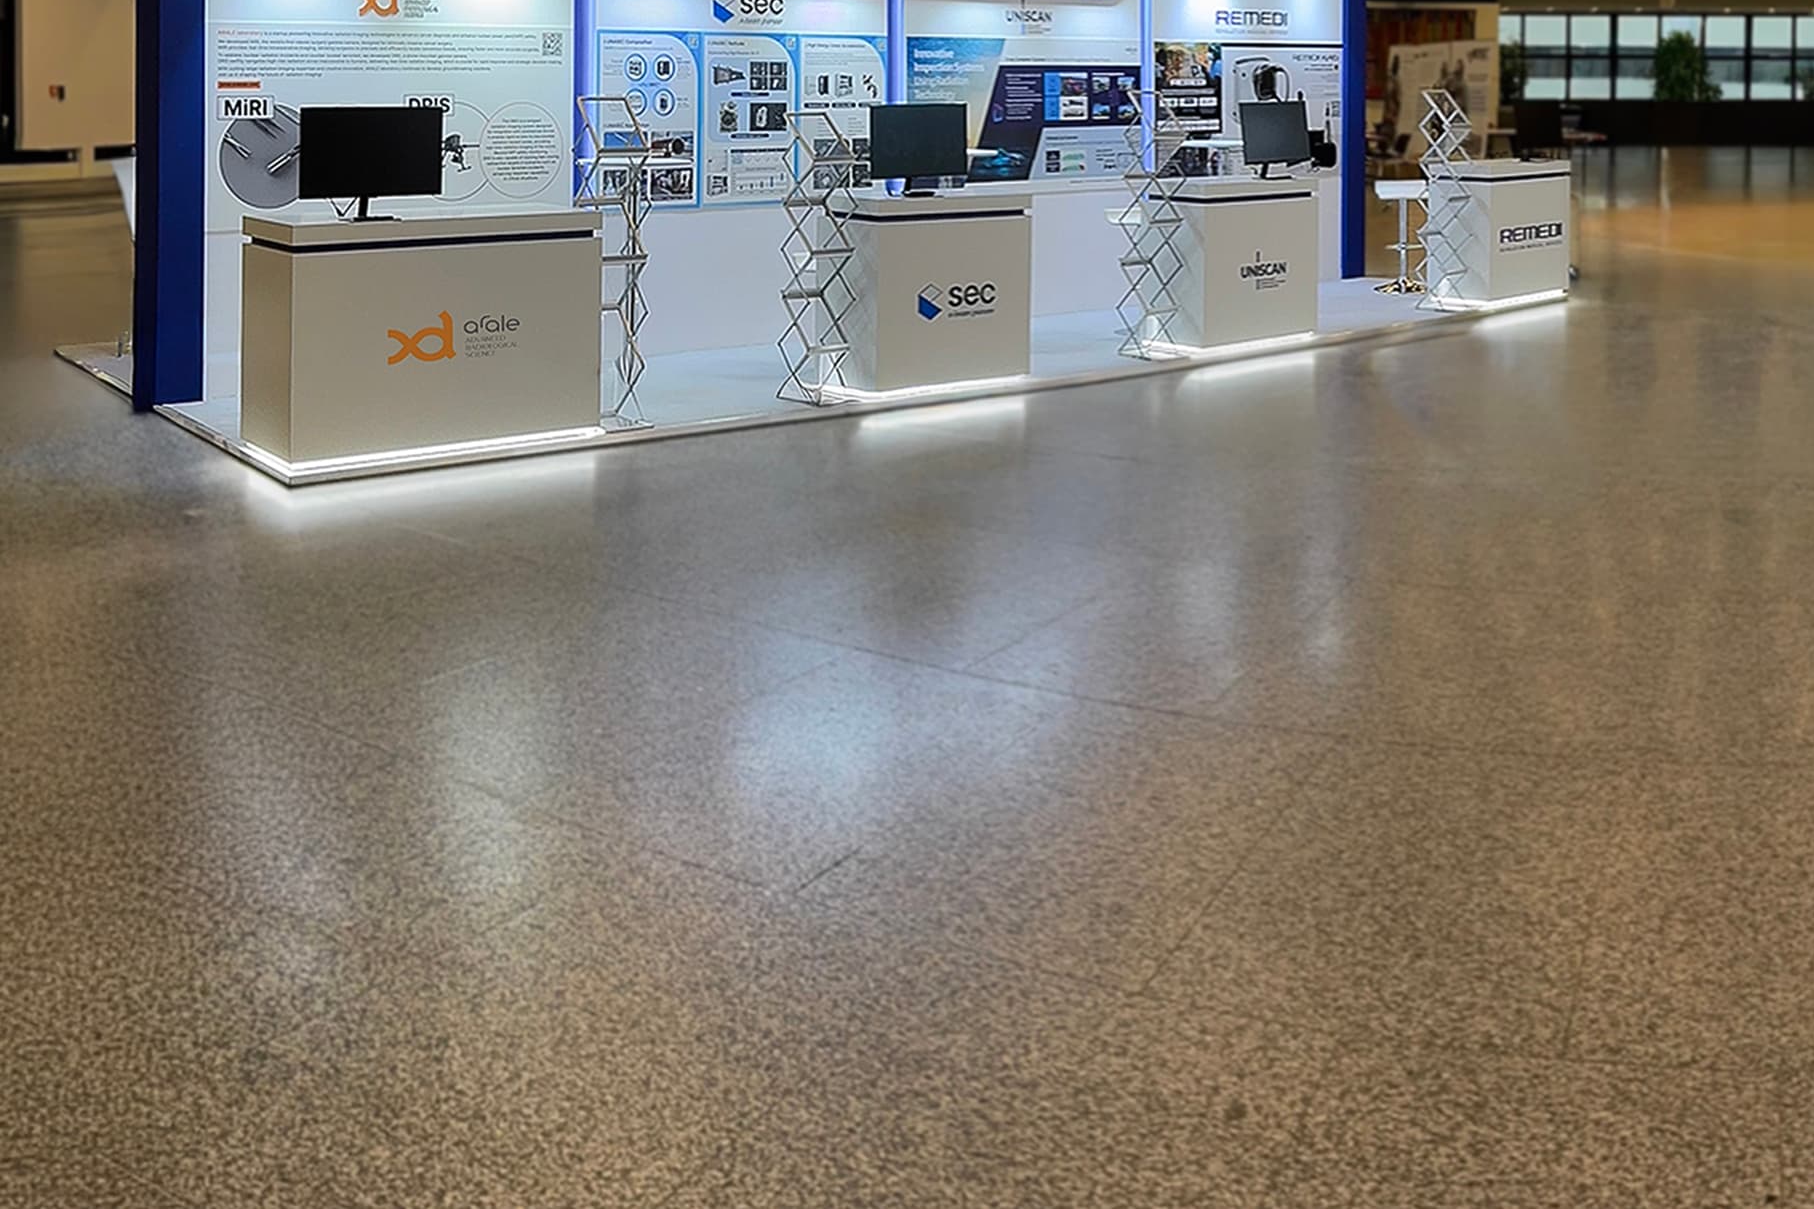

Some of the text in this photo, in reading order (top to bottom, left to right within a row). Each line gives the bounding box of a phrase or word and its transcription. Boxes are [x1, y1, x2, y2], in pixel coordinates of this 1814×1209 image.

[1215, 11, 1288, 27] REMEDI
[224, 99, 268, 116] MiRI
[1500, 222, 1563, 244] REMEDI
[1240, 262, 1287, 279] UNISCAN
[948, 284, 996, 307] sec
[463, 314, 521, 335] arale
[465, 342, 518, 351] RADIOLOGICAL
